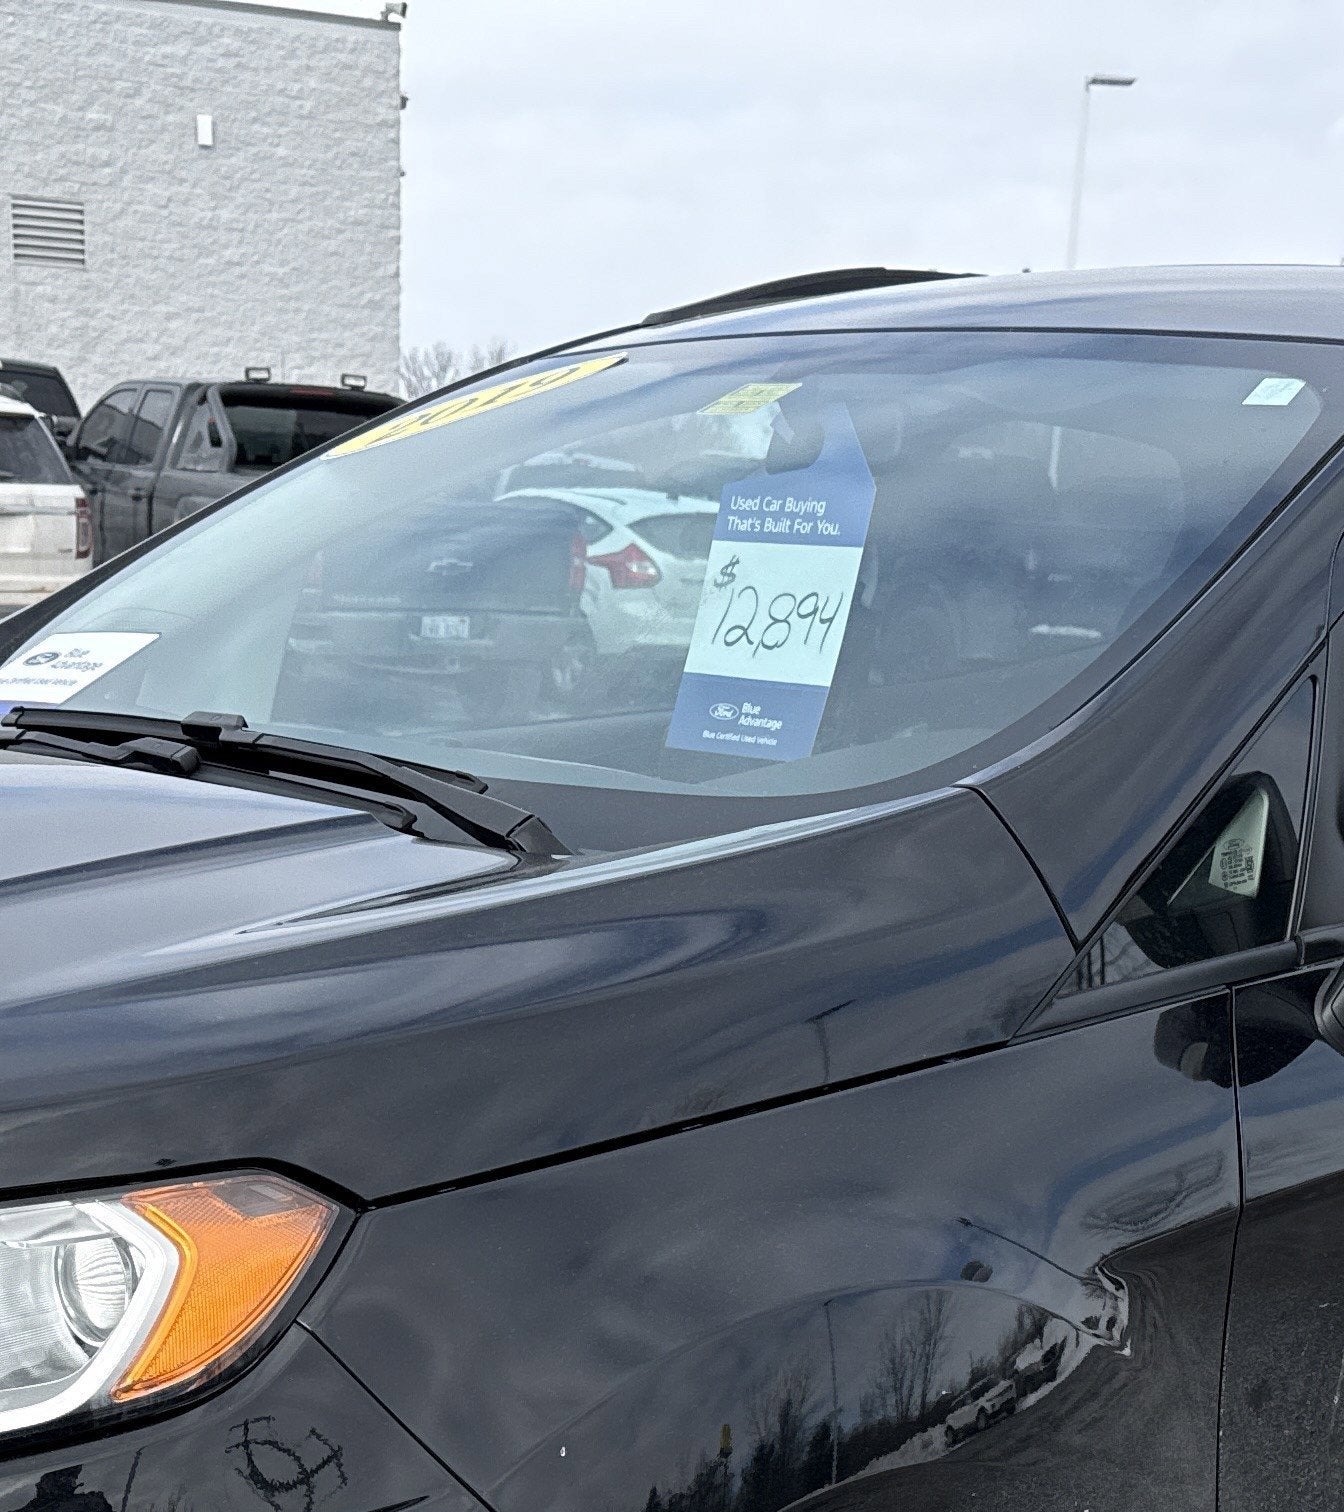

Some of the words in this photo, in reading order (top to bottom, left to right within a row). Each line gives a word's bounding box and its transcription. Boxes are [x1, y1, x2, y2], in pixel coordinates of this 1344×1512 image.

[730, 496, 760, 511] Used
[762, 497, 783, 511] Car
[784, 497, 827, 517] Buying
[727, 515, 761, 533] That's
[763, 517, 790, 534] Built
[792, 518, 814, 535] For
[816, 519, 841, 536] You.
[713, 554, 740, 590] $
[712, 585, 844, 658] 12,894
[741, 702, 762, 715] Blue
[738, 714, 783, 731] Advantage
